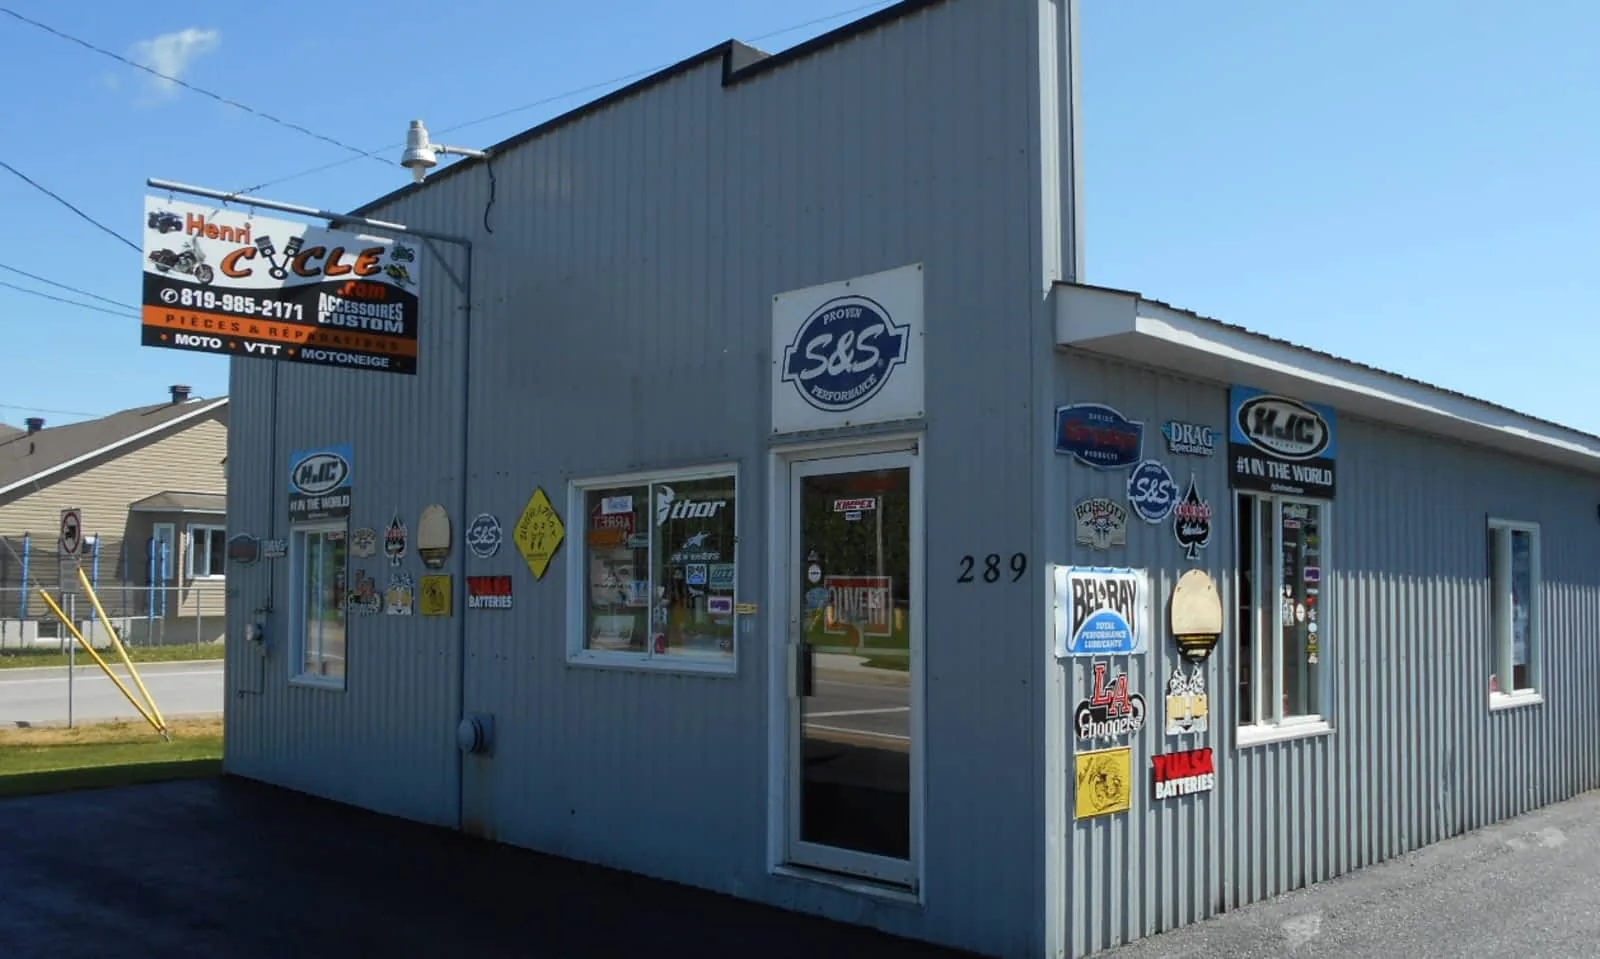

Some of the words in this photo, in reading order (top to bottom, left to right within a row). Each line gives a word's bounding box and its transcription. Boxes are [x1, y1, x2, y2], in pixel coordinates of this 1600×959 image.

[186, 212, 252, 245] Henri
[180, 288, 303, 320] 819-985-2171
[823, 307, 862, 325] PROVEN
[249, 325, 258, 334] &
[318, 311, 404, 334] CUSTOM
[175, 334, 222, 349] MOTO
[243, 341, 281, 356] VTT
[799, 323, 885, 380] S&S
[300, 347, 390, 367] MOTONEIGE
[811, 373, 878, 401] PERFORMANCE
[1171, 422, 1213, 447] DRAG
[1250, 407, 1315, 444] HJC
[1266, 460, 1291, 480] THE
[1292, 464, 1333, 486] WORLD
[1135, 477, 1171, 503] S&S
[671, 499, 727, 519] thor
[470, 525, 497, 544] S&S
[956, 552, 1027, 583] 289
[469, 595, 512, 608] BATTERIES
[827, 587, 889, 625] OUVERT
[1091, 664, 1132, 718] LA
[1155, 773, 1214, 800] BATTERIES
